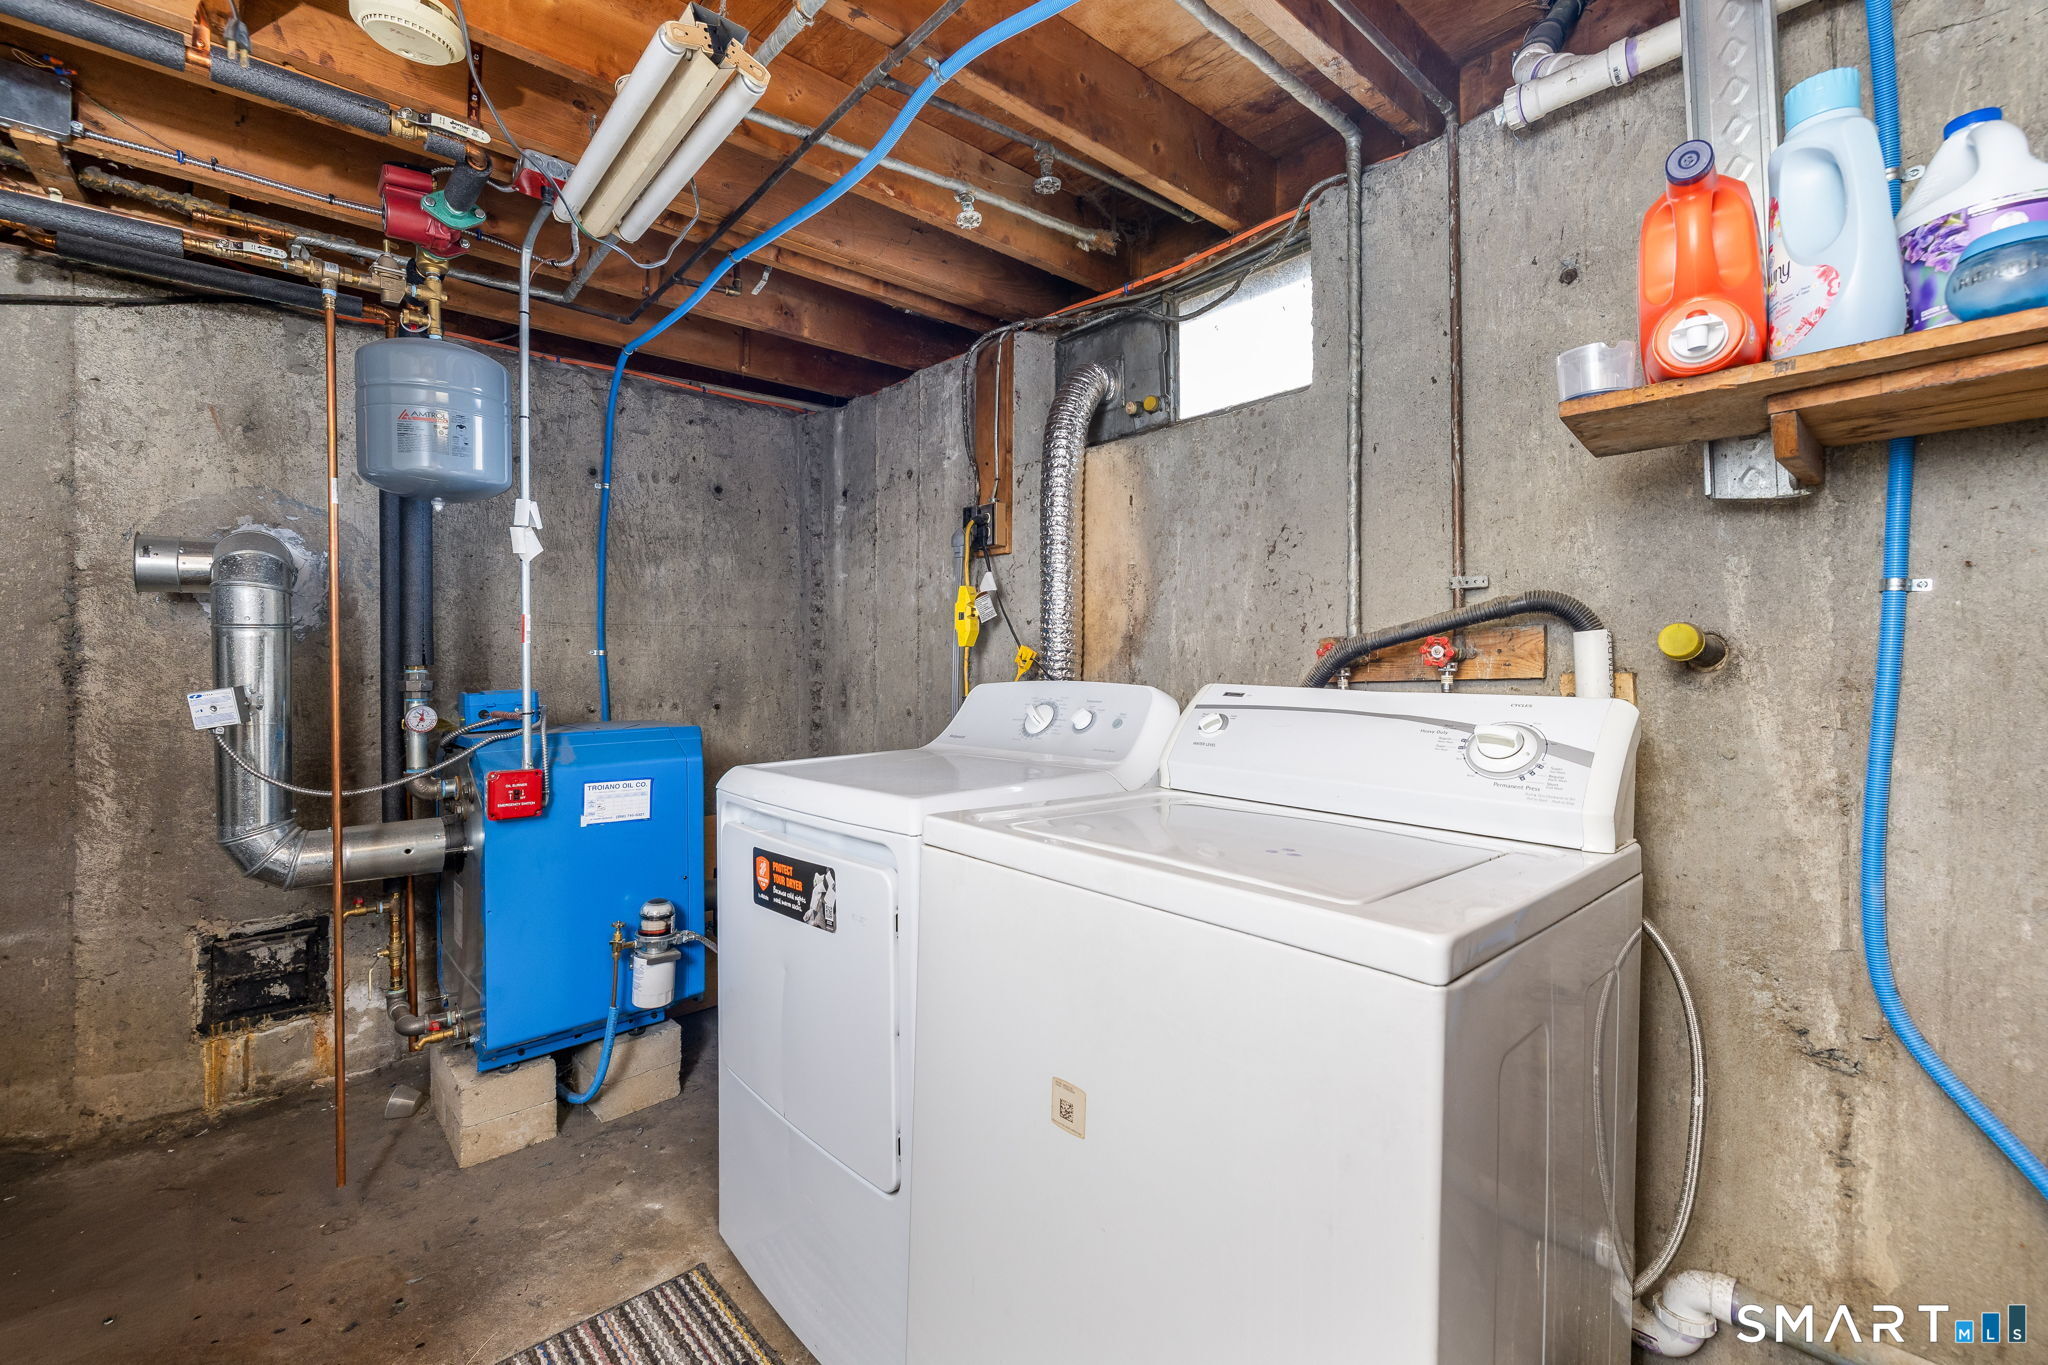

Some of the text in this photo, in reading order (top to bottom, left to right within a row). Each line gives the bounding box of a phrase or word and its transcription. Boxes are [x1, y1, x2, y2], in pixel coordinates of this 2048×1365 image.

[411, 410, 446, 420] AMTROL
[588, 783, 621, 791] TROIANO
[1493, 782, 1524, 791] Permanent
[772, 861, 793, 877] PROTECT
